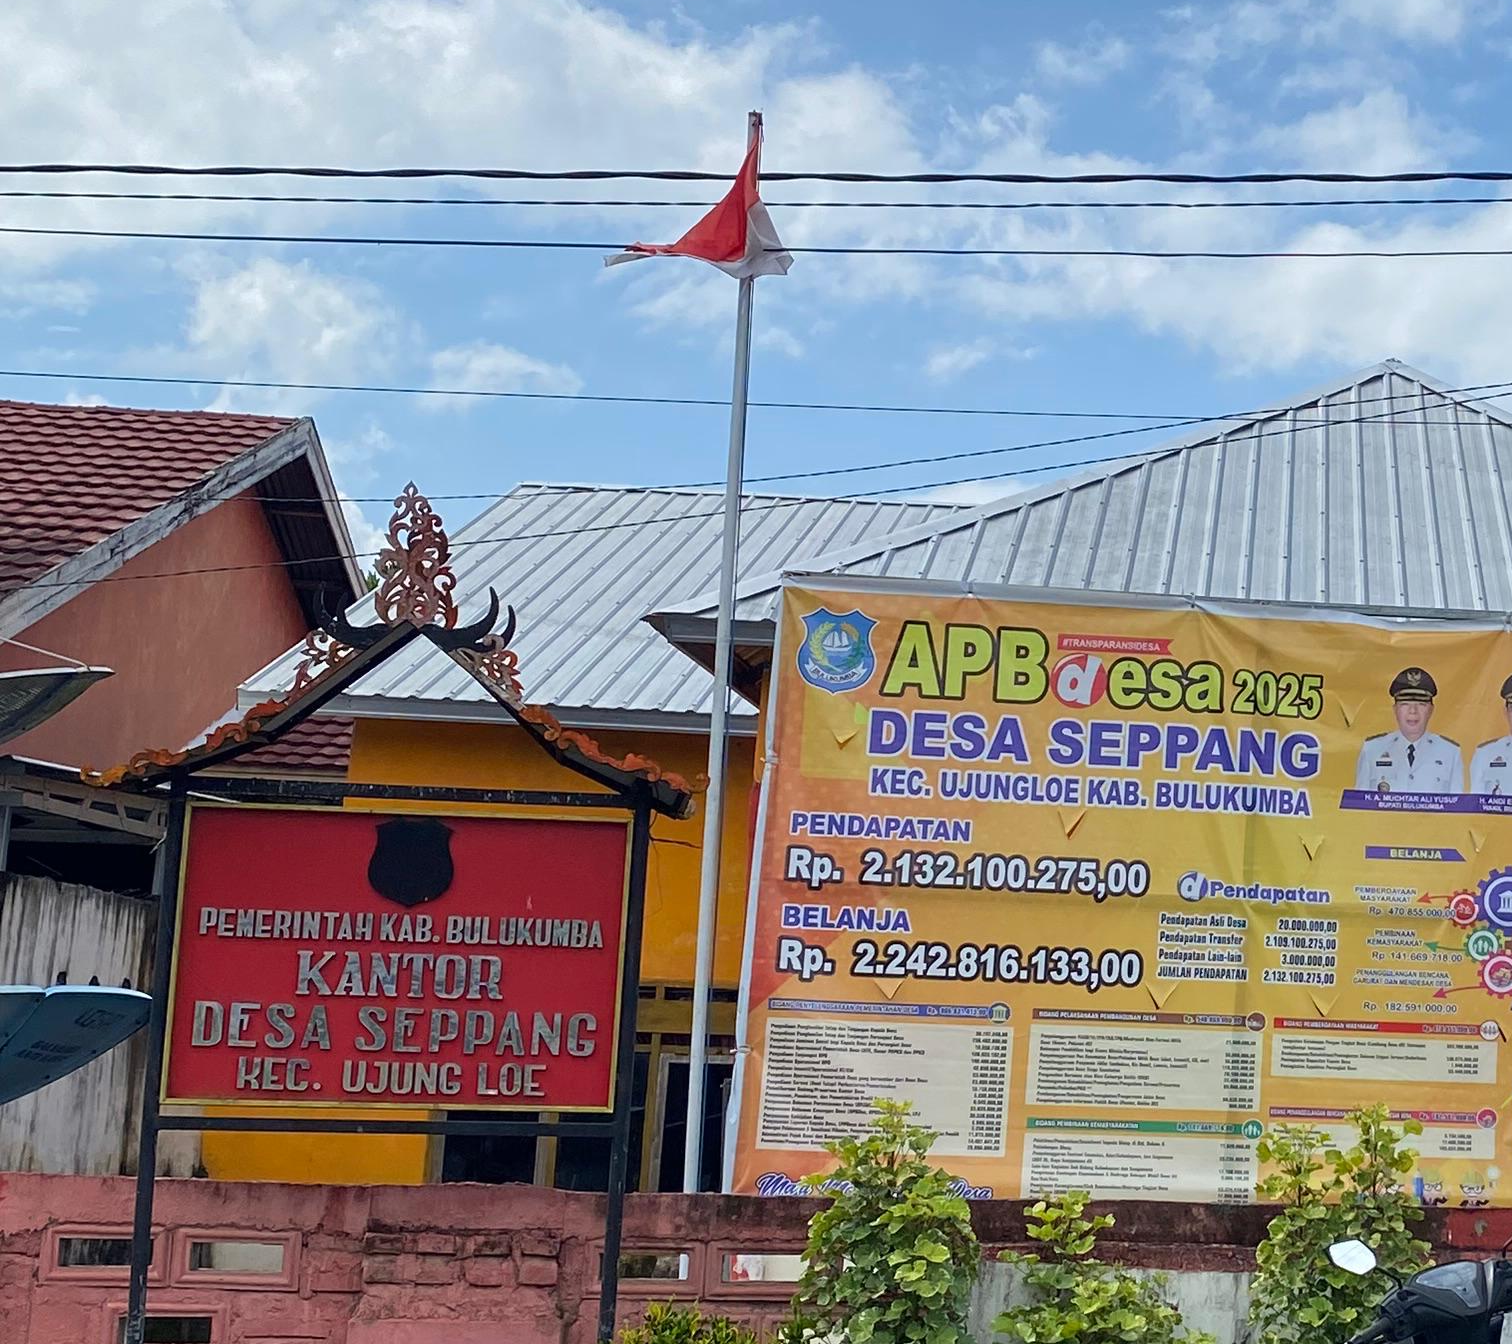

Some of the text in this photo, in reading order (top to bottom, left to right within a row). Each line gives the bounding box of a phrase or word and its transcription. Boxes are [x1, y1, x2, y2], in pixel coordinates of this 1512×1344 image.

[1062, 637, 1161, 652] #TRANSPARANSIDESA
[1231, 668, 1324, 719] 2025
[867, 709, 1320, 778] DESA SEPPANG
[871, 768, 1311, 817] KEC. UJUNGLOE KAB. BULUKUMBA
[791, 813, 971, 842] PENDAPATAN
[1390, 848, 1442, 860] BELANJA
[786, 847, 1148, 899] Rp. 2.132.100.275,00
[1209, 881, 1331, 904] Pendapatan
[1355, 887, 1416, 896] PEMBERDAYAAN
[1360, 895, 1410, 903] MASYARAKAT
[199, 906, 604, 948] PEMERINTAH KAB. BULUKUMBA
[782, 906, 911, 932] BELANJA
[1160, 913, 1338, 933] Pendapatan Asli Desa 20.000.000,00
[1159, 931, 1207, 945] Pendapatan
[1209, 933, 1243, 945] Transfer
[1375, 929, 1416, 937] PEMBINAAN
[782, 939, 1142, 990] Rp. 2.242.816.133,00
[1158, 949, 1336, 968] Pendapatan Lain-lain 3.000.000,00
[295, 949, 503, 1000] KANTOR
[1157, 966, 1192, 979] JUMLAH
[1193, 967, 1248, 981] PENDAPATAN
[191, 1000, 597, 1057] DESA SEPPANG
[236, 1055, 547, 1097] KEC. UJUNG LOE
